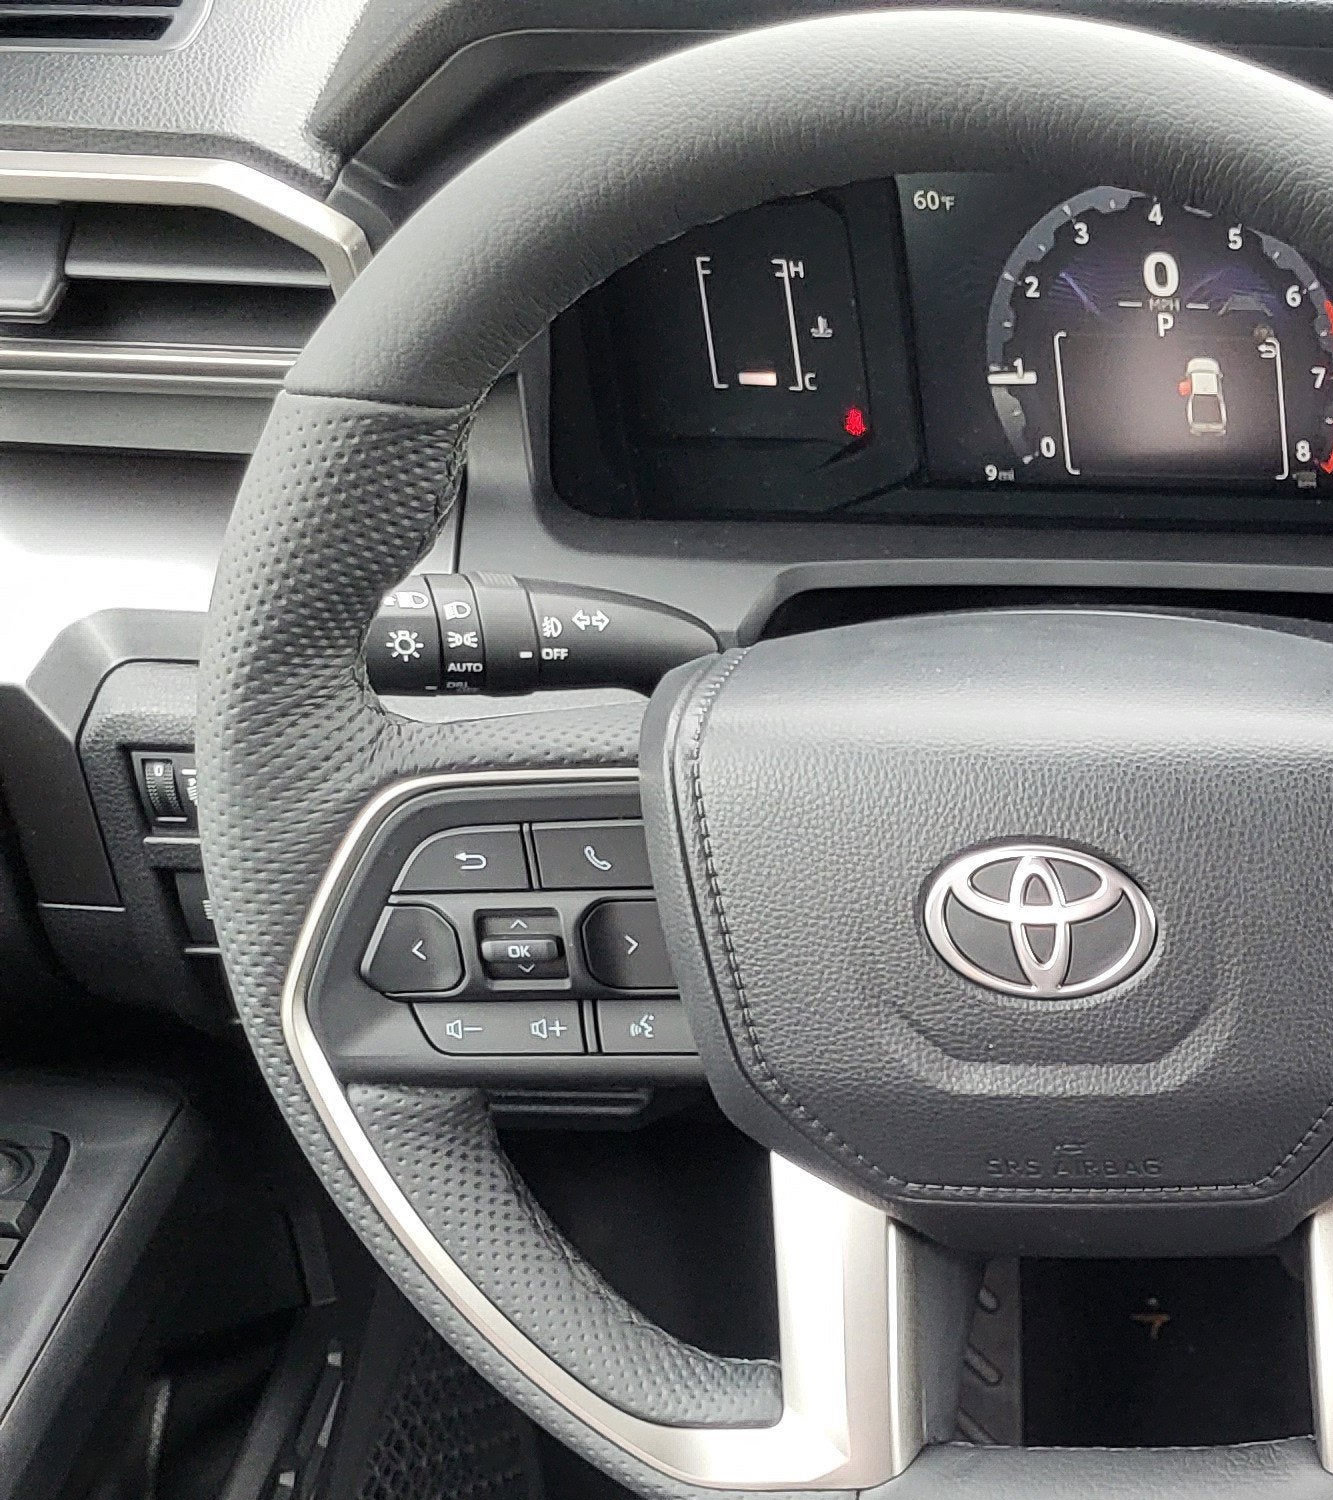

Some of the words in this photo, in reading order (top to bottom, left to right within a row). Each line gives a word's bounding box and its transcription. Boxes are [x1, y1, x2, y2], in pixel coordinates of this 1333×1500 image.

[1148, 203, 1163, 226] 4
[1074, 222, 1089, 245] 3
[1228, 227, 1243, 250] 5
[1143, 252, 1180, 297] 0
[1025, 276, 1040, 299] 2
[1286, 285, 1302, 308] 6
[1157, 313, 1175, 337] P
[1310, 366, 1326, 389] 7
[1040, 436, 1056, 458] 0
[1296, 439, 1312, 462] 8
[541, 648, 569, 661] OFF
[447, 661, 484, 673] AUTO
[507, 945, 532, 959] OK
